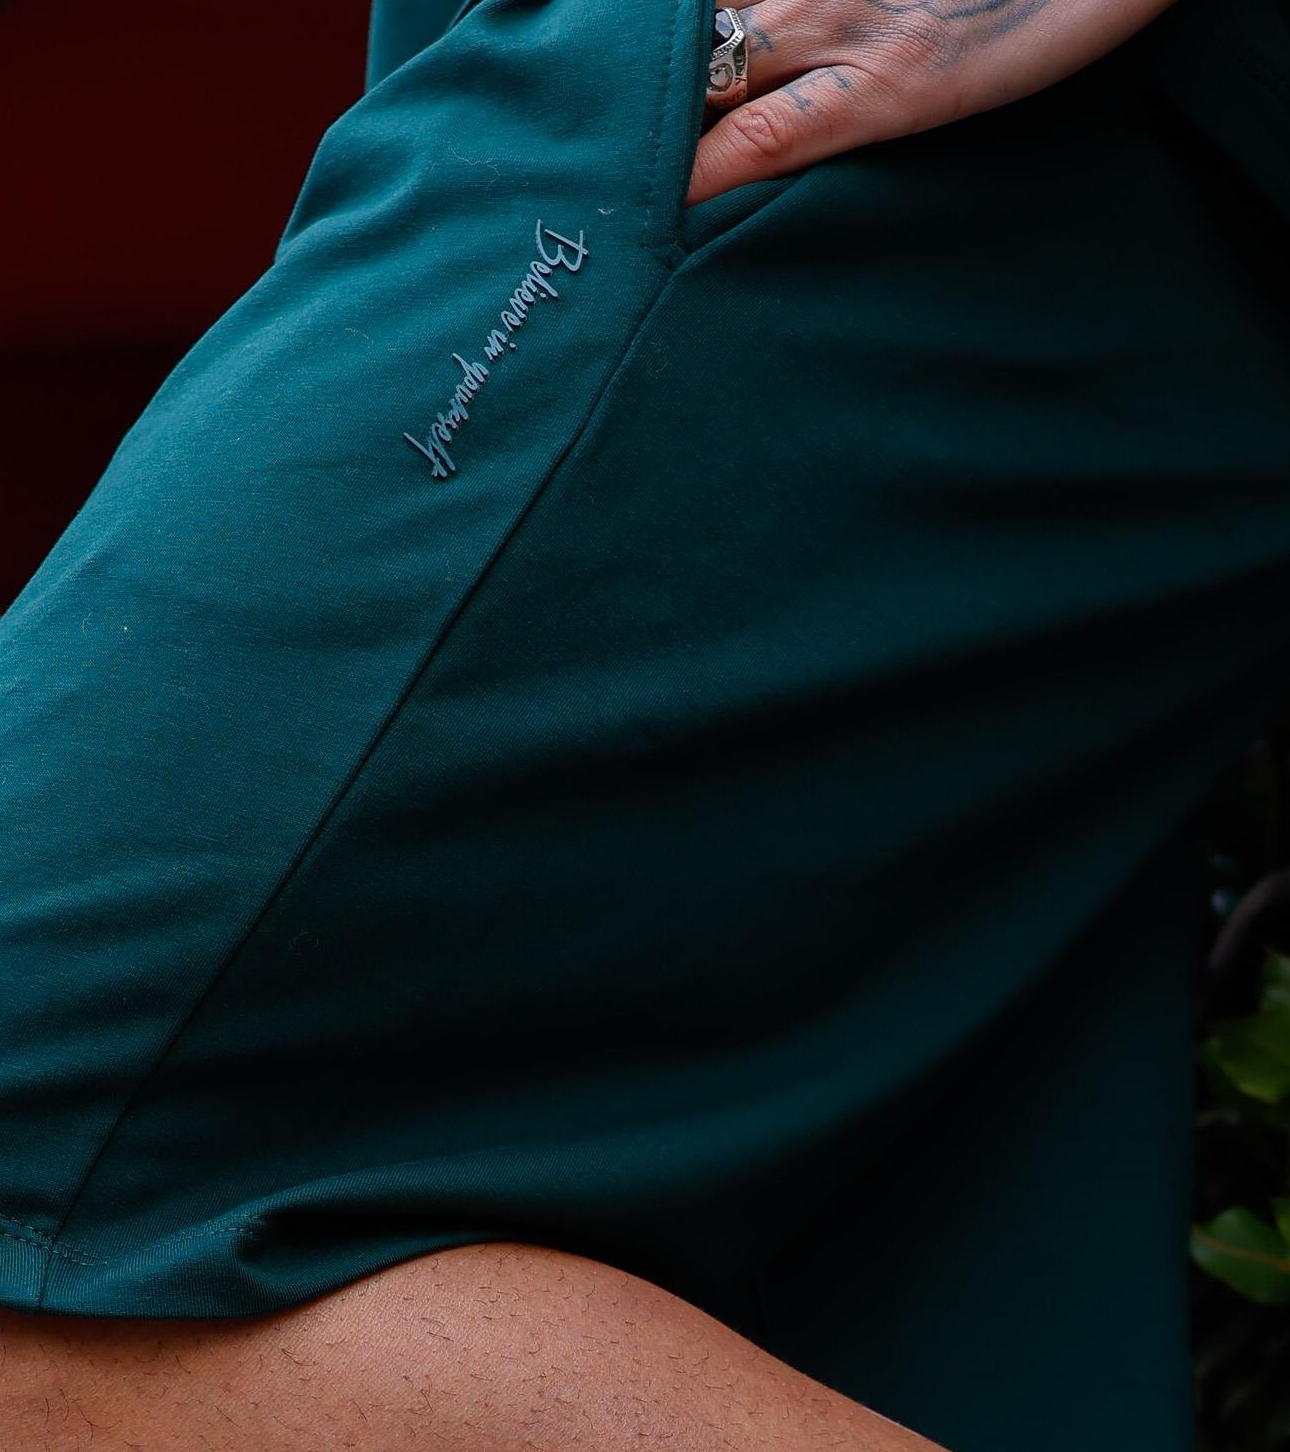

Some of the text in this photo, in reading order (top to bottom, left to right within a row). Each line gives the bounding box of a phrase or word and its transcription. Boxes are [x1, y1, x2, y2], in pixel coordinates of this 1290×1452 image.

[403, 218, 589, 478] Believe in yourself
